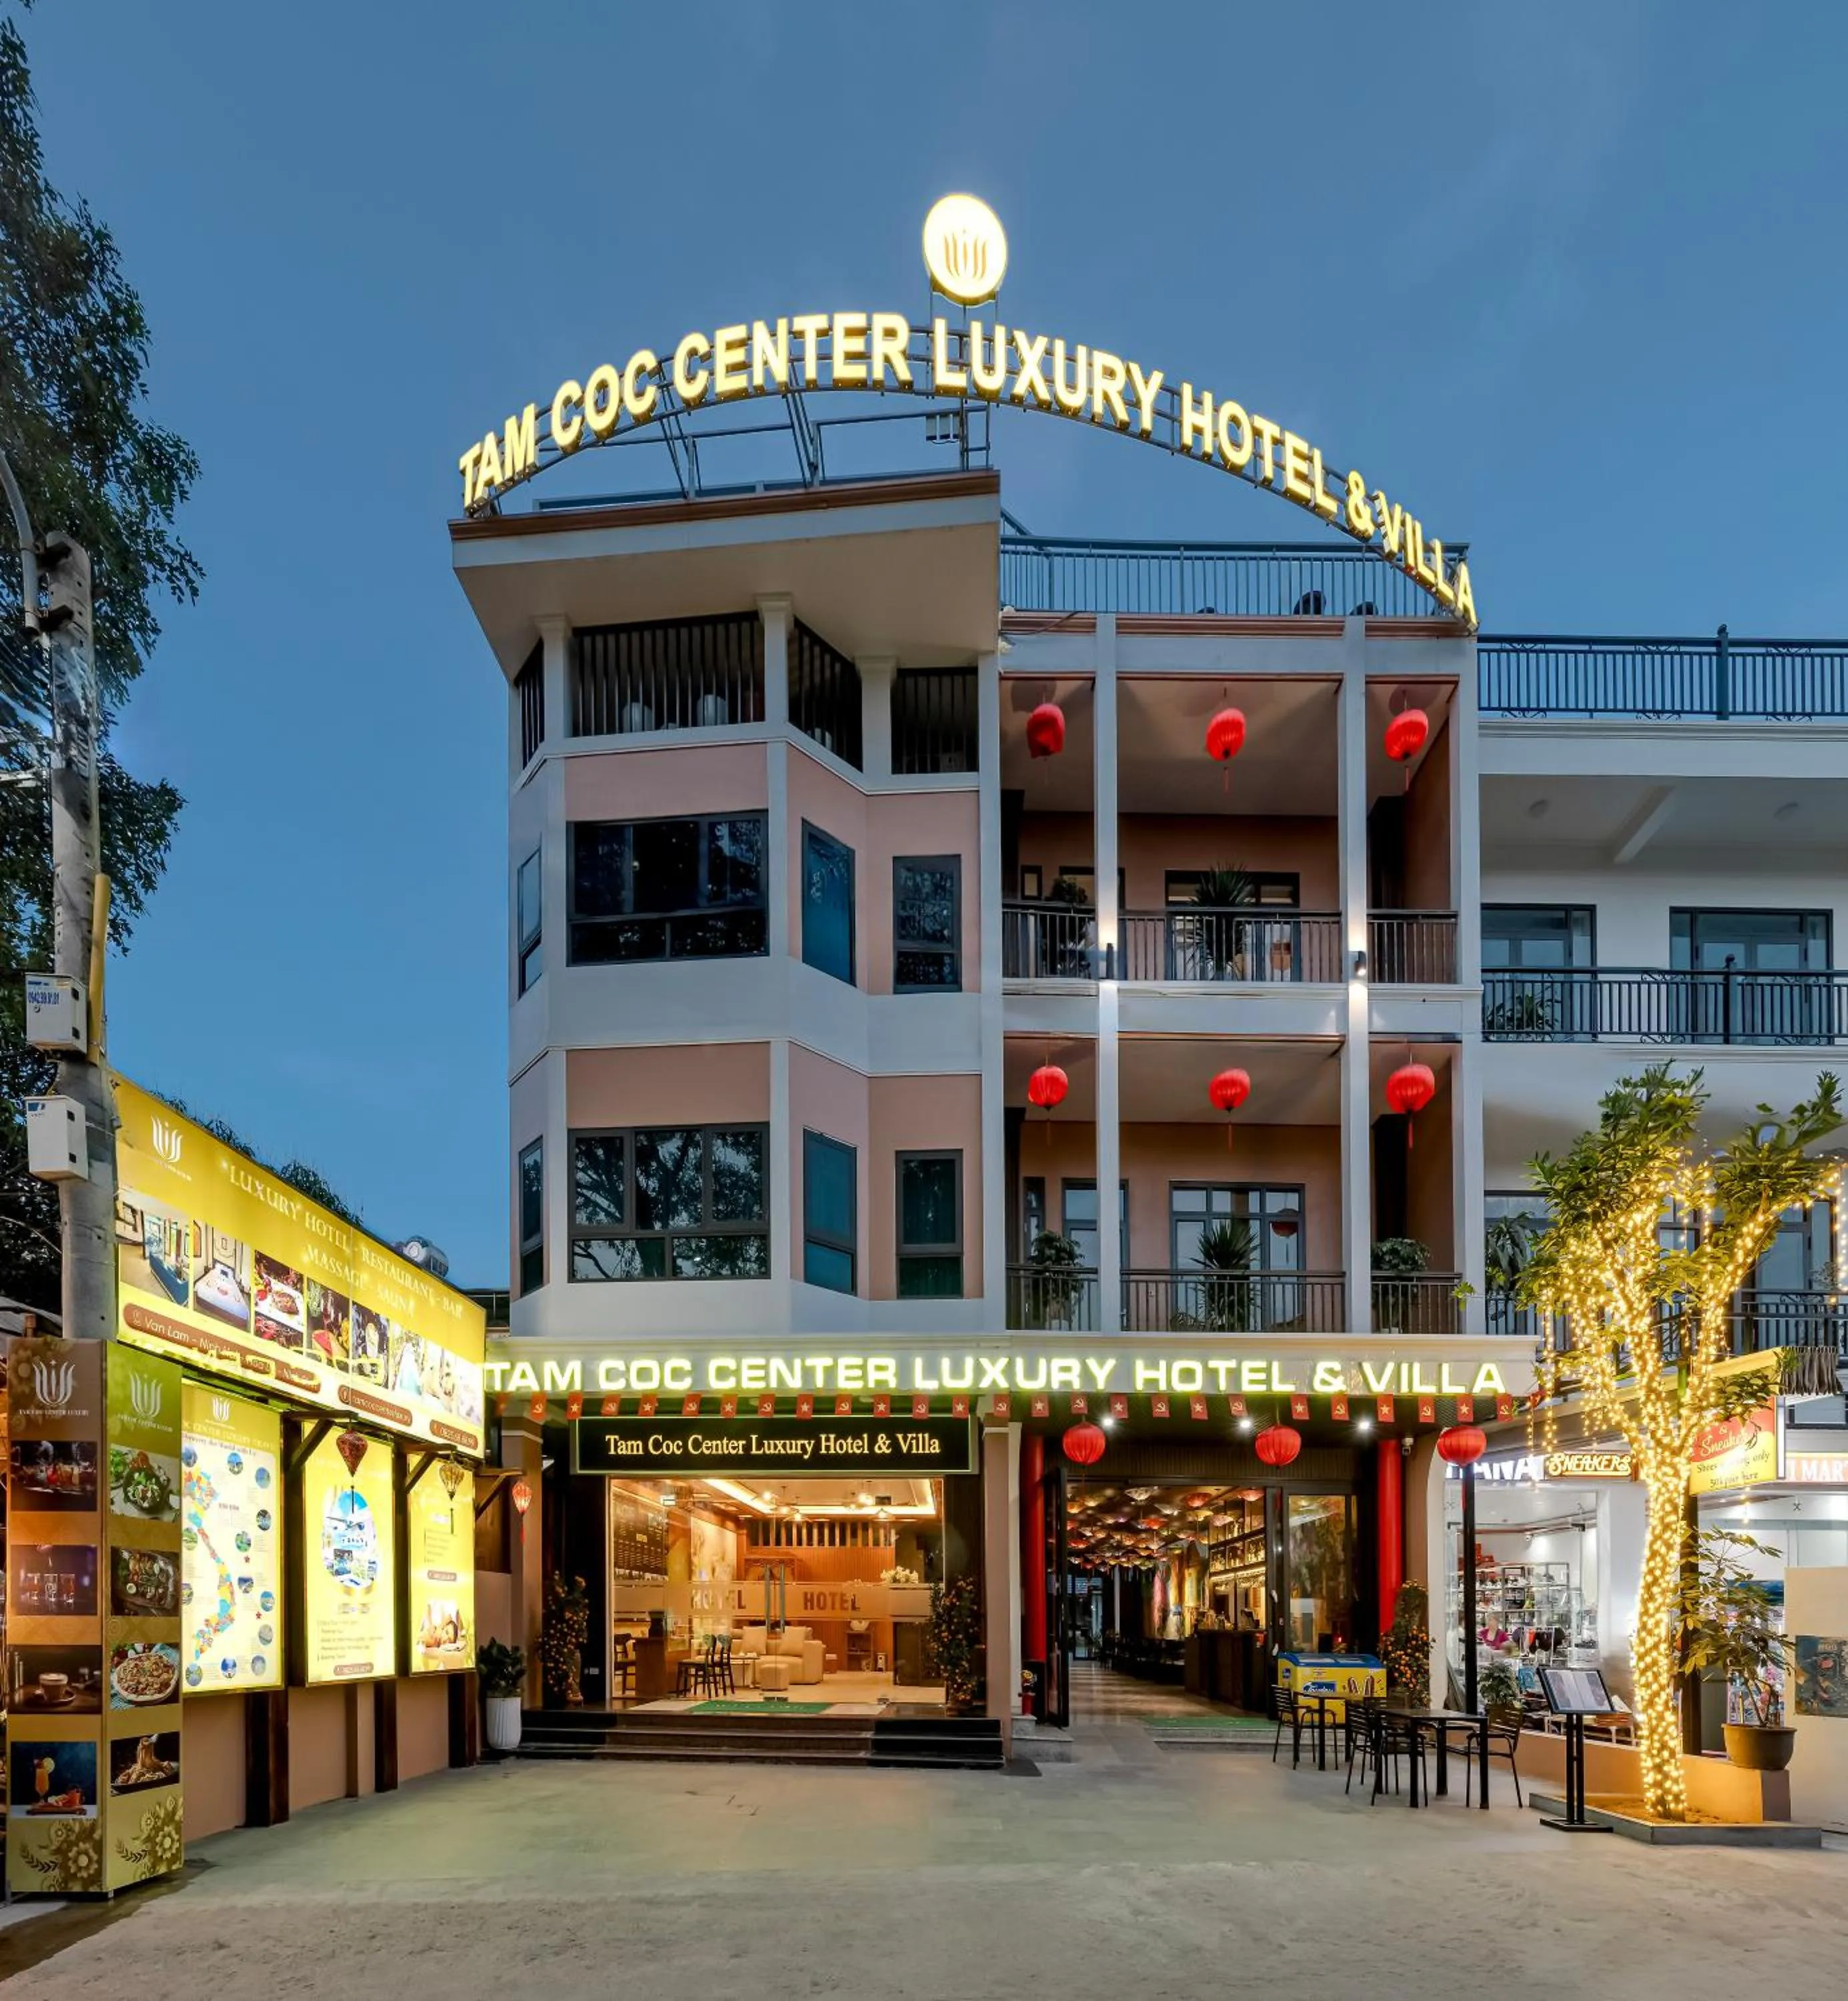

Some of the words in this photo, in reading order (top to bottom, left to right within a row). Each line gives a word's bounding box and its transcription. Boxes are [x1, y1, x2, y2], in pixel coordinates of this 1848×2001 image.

[459, 403, 536, 512] TAM
[550, 348, 660, 454] COC
[674, 312, 914, 407] CENTER
[933, 316, 1164, 437] LUXURY
[1180, 382, 1338, 519] HOTEL
[1344, 470, 1374, 541] &
[1374, 490, 1478, 632] VILLA
[230, 1165, 300, 1221] LUXURY
[305, 1211, 350, 1253] HOTEL
[362, 1246, 434, 1305] RESTAURANT
[443, 1297, 462, 1319] BAR
[306, 1245, 366, 1290] MASSAGE
[377, 1285, 415, 1318] SAUNA
[144, 1317, 165, 1335] Van
[168, 1325, 189, 1343] Lam
[485, 1360, 581, 1391] TAM
[598, 1359, 692, 1390] COC
[708, 1357, 897, 1389] CENTER
[915, 1357, 1116, 1389] LUXURY
[1135, 1359, 1296, 1391] HOTEL
[1313, 1361, 1347, 1392] &
[1361, 1362, 1506, 1393] VILLA
[1719, 1425, 1728, 1435] &
[606, 1435, 643, 1455] Tam
[648, 1435, 683, 1455] Coc
[688, 1435, 747, 1455] Center
[751, 1435, 815, 1459] Luxury
[820, 1433, 869, 1454] Hotel
[874, 1433, 892, 1454] &
[897, 1433, 941, 1454] Villa
[1548, 1453, 1631, 1476] SNEAKERS
[1697, 1461, 1717, 1473] Shoes
[1753, 1450, 1770, 1463] only
[803, 1591, 860, 1611] HOTEL
